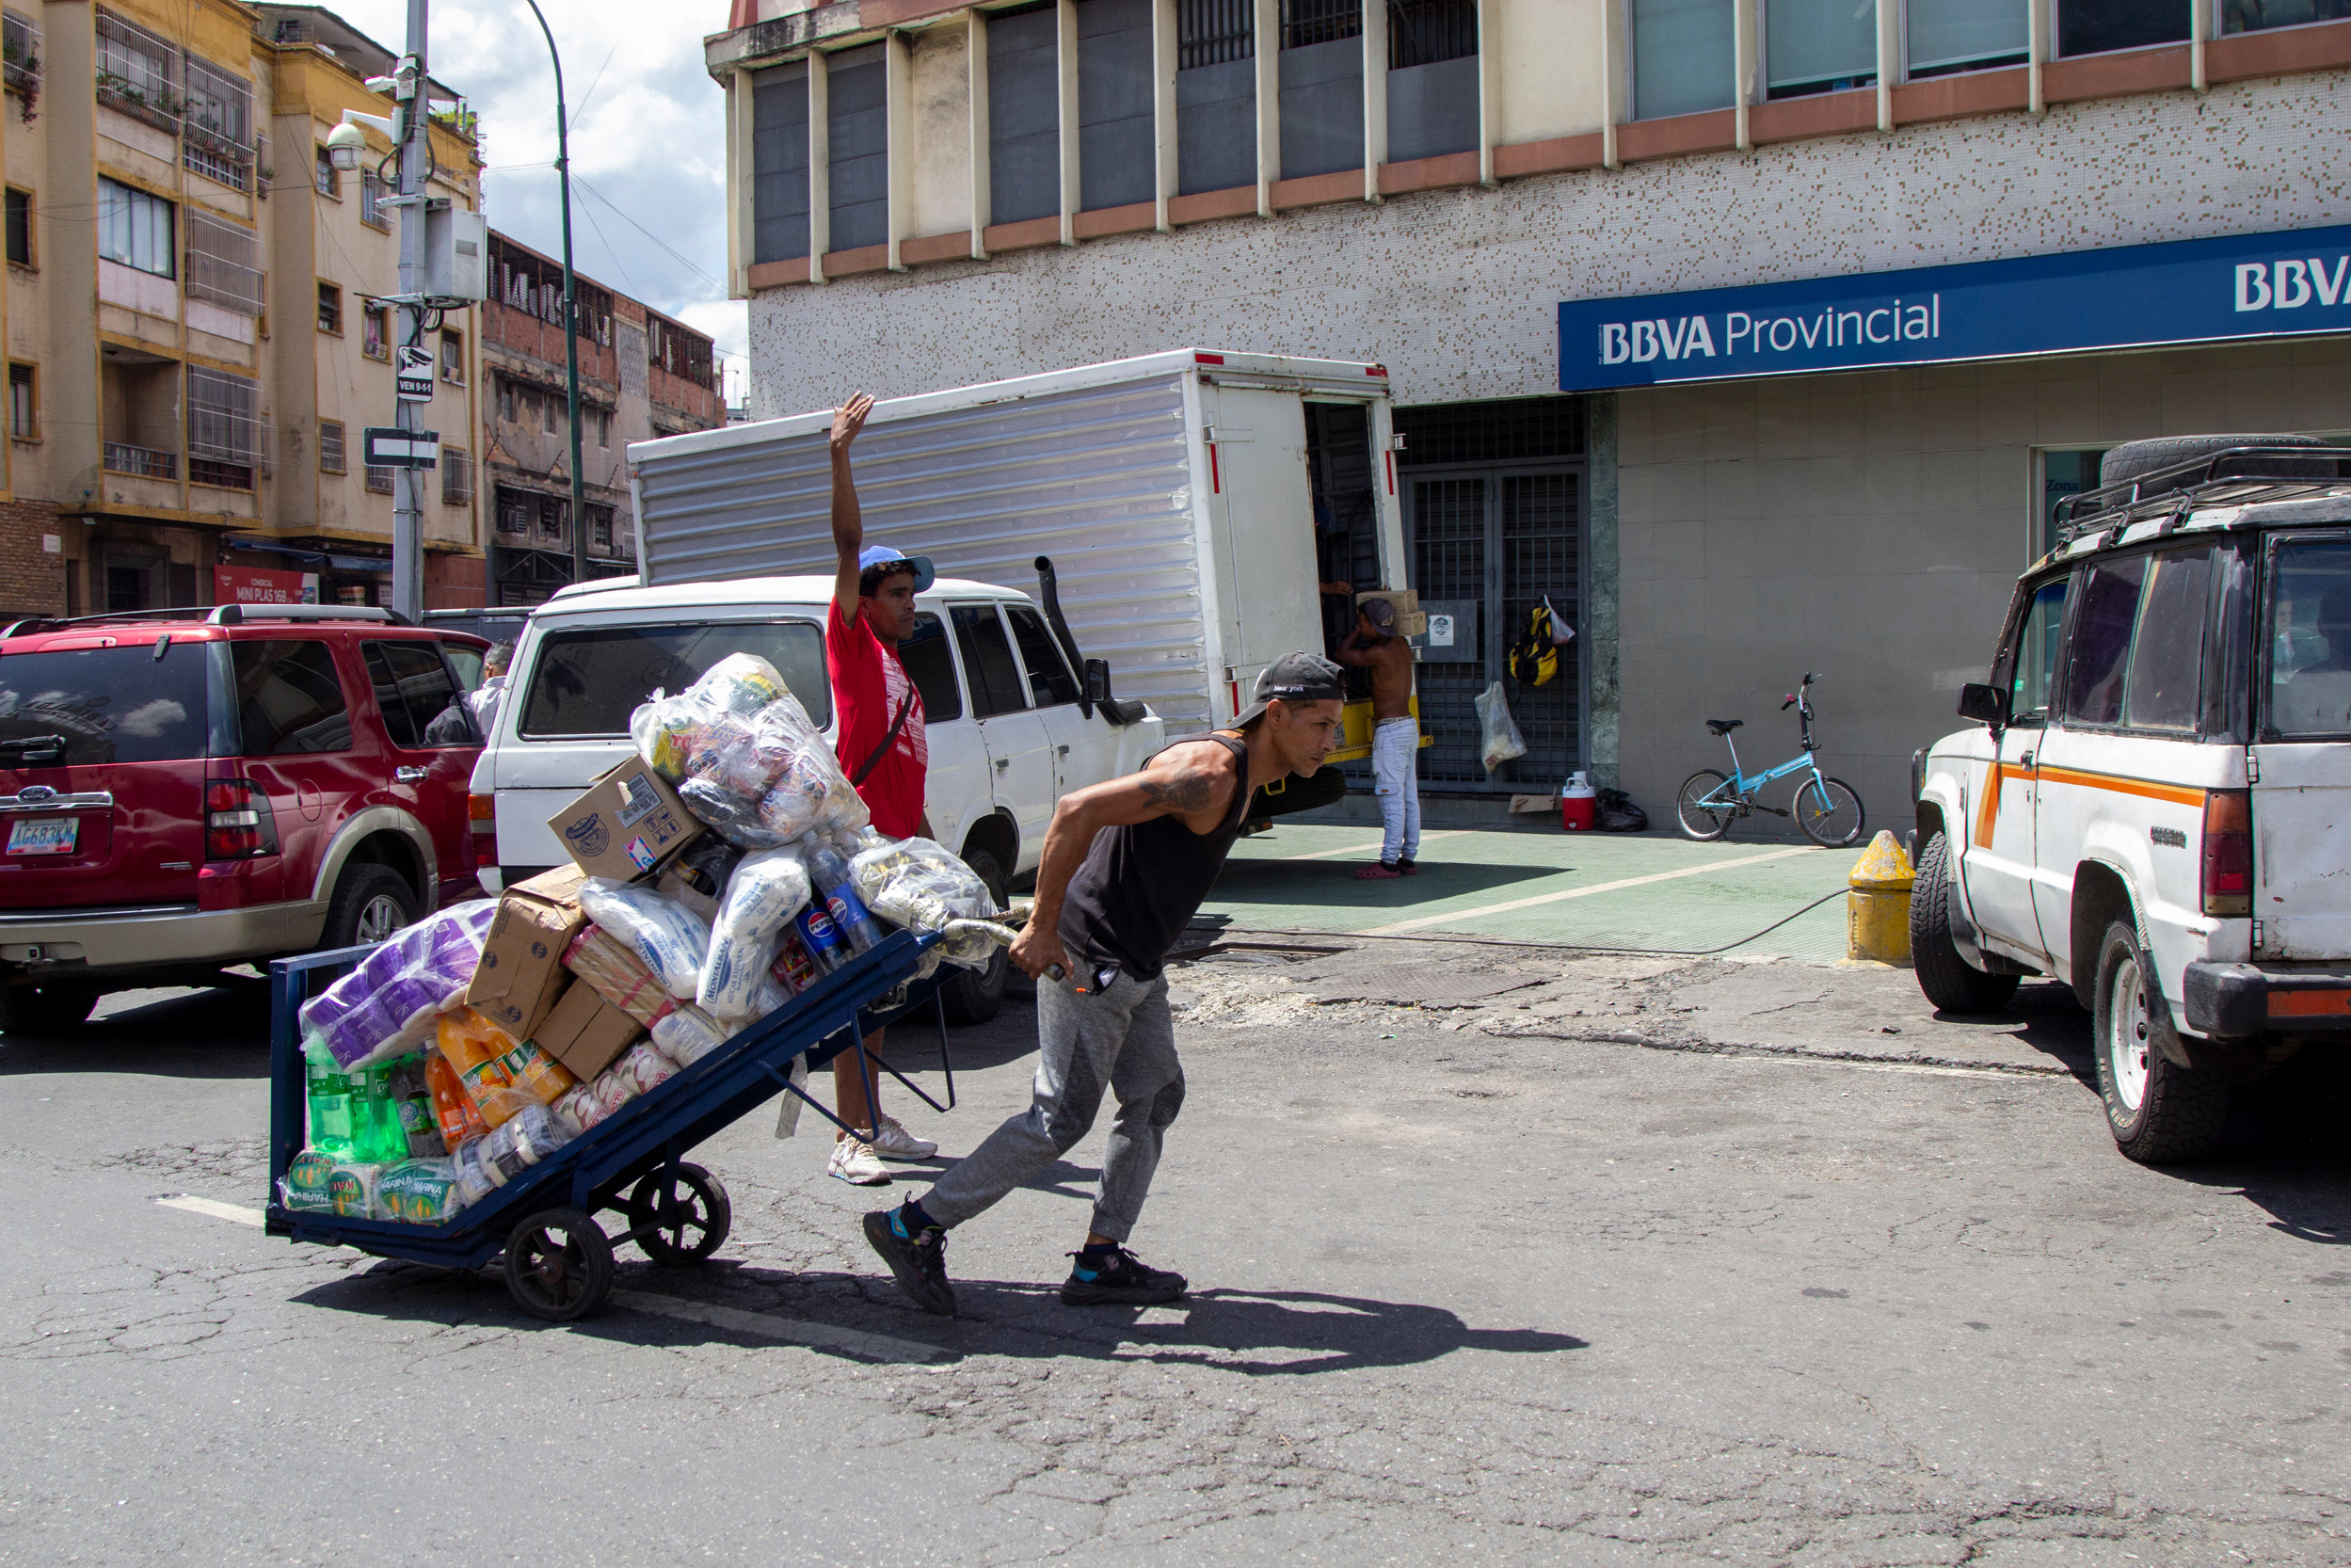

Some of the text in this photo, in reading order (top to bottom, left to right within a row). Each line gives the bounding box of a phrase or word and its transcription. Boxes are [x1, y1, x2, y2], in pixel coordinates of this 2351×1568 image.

[1603, 293, 1939, 364] BBVA Provincial
[399, 380, 431, 392] VEN 9-1-1
[2047, 479, 2078, 491] Zona
[250, 578, 274, 587] COMERCIAL
[236, 586, 253, 600] MINI
[254, 588, 273, 602] PLAS
[274, 590, 286, 602] 168
[832, 902, 846, 915] EPSI
[810, 918, 833, 933] PEPSI
[707, 938, 729, 1000] MONTALBAN
[379, 1176, 413, 1191] HARINA
[412, 1180, 442, 1195] HARINA
[293, 1191, 329, 1204] HARINA
